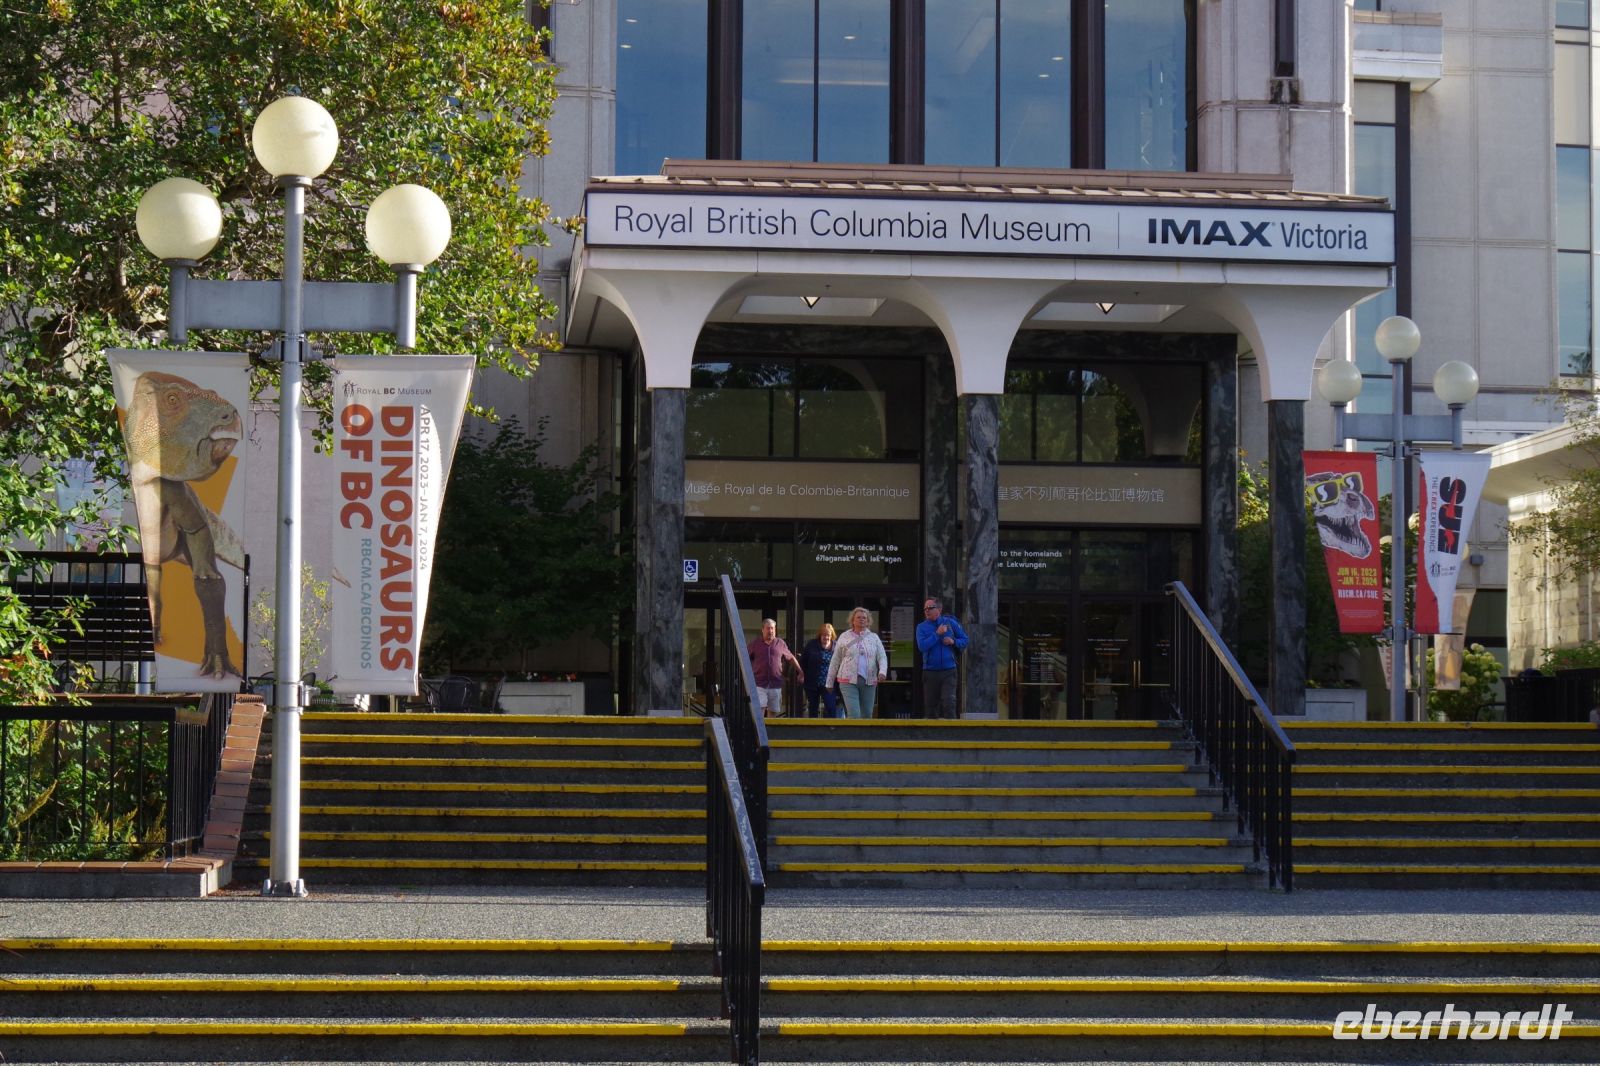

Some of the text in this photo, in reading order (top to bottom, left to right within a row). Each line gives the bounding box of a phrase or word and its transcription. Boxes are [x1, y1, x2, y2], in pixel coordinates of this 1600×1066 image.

[614, 205, 1368, 250] Royal British Columbia Museum IMAX Victoria
[383, 387, 396, 395] BC
[419, 407, 431, 436] APR
[418, 437, 430, 455] 17,
[340, 403, 374, 530] OF BC
[684, 482, 910, 499] Musée Royal de la Colombie-Britannique
[1431, 477, 1439, 491] THE
[1437, 476, 1467, 555] SUE
[379, 405, 414, 672] DINOSAURS
[418, 527, 428, 536] 7,
[1428, 511, 1437, 553] EXPERIENCE
[419, 540, 428, 570] 2024
[1006, 561, 1047, 570] Lekwungen
[1362, 577, 1378, 586] 2024
[360, 538, 372, 669] RBCM.CA/BCDINOS
